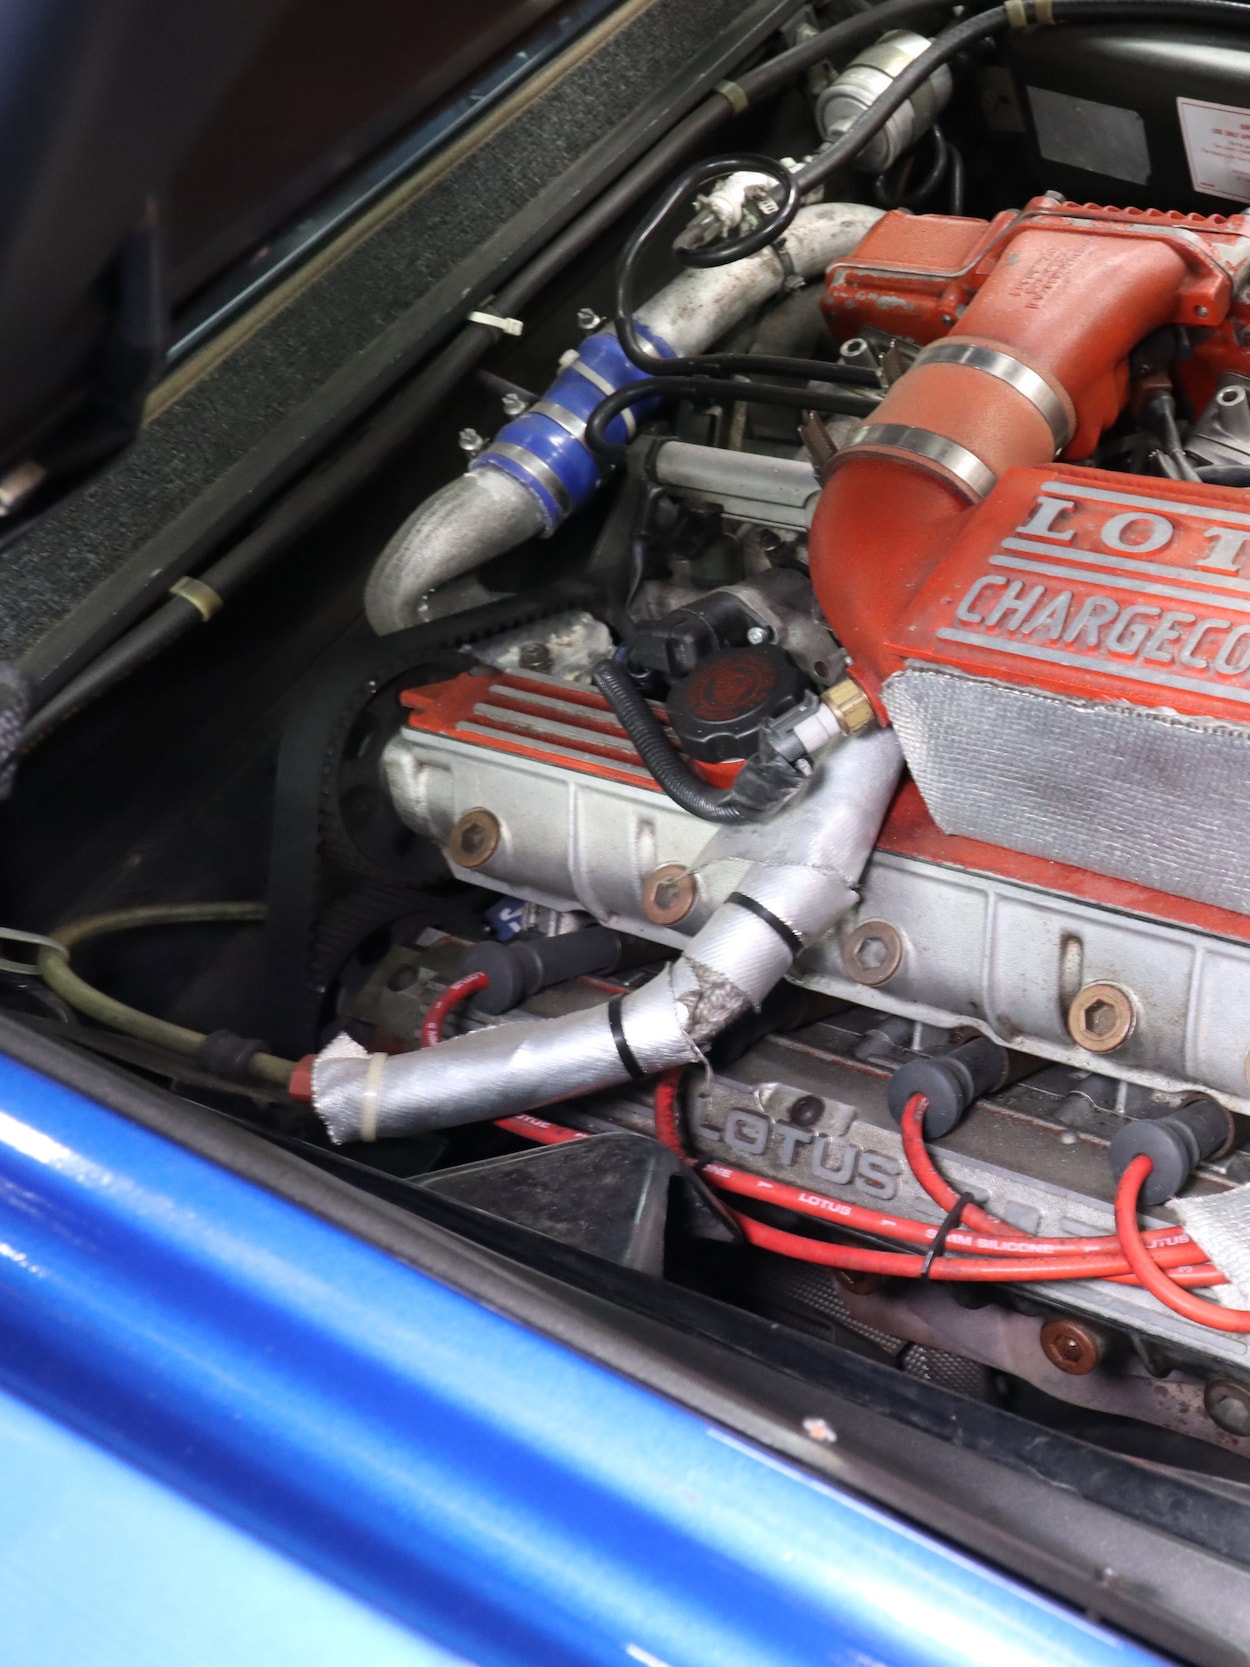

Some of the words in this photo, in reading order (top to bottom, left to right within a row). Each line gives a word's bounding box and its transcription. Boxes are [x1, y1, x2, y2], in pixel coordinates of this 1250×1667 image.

[693, 1097, 901, 1200] LOTUS
[798, 1192, 852, 1215] LOTUS
[977, 1237, 1055, 1254] SILICONE
